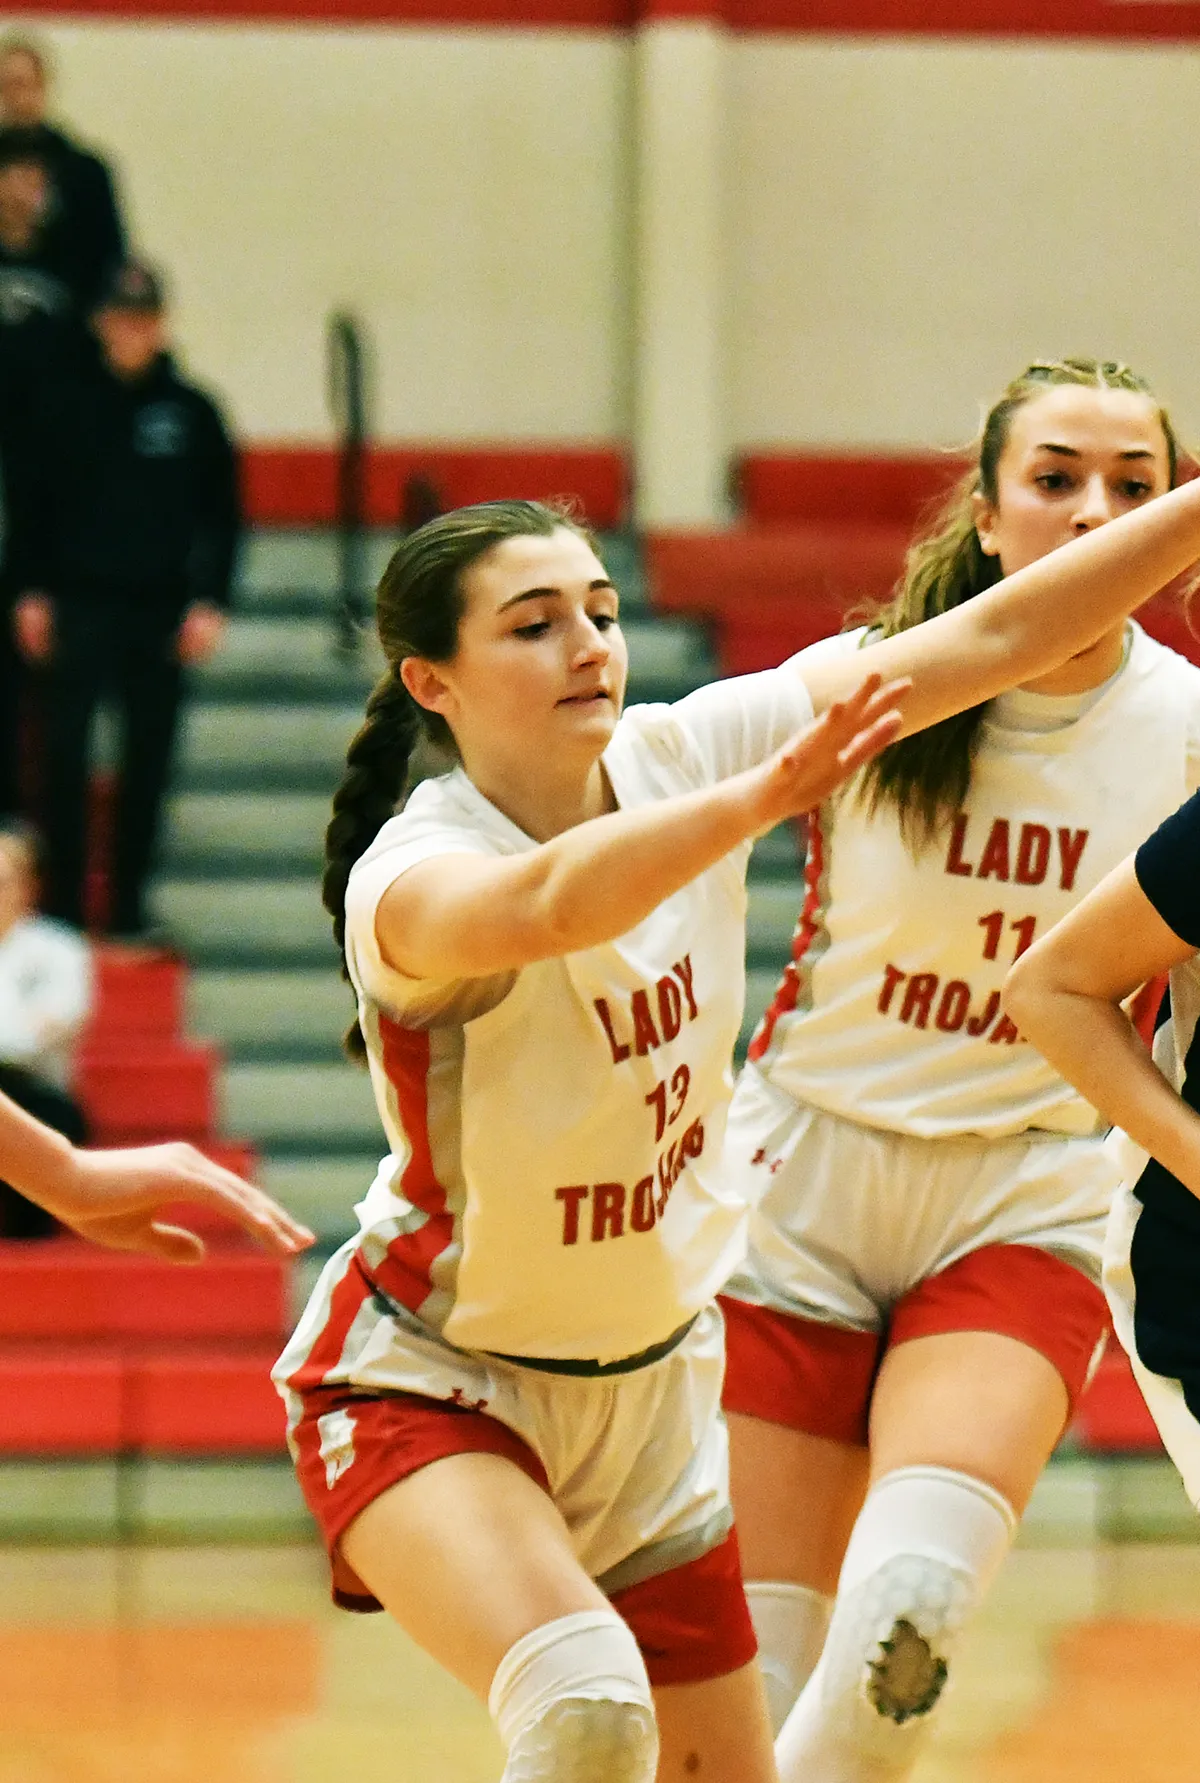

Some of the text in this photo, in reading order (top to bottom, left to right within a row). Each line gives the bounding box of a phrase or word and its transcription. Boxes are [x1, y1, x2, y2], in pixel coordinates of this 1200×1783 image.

[944, 812, 1089, 892] LADY
[978, 908, 1037, 966] 11
[594, 953, 699, 1065] LADY
[877, 963, 1029, 1046] TROJA
[645, 1063, 691, 1144] 13
